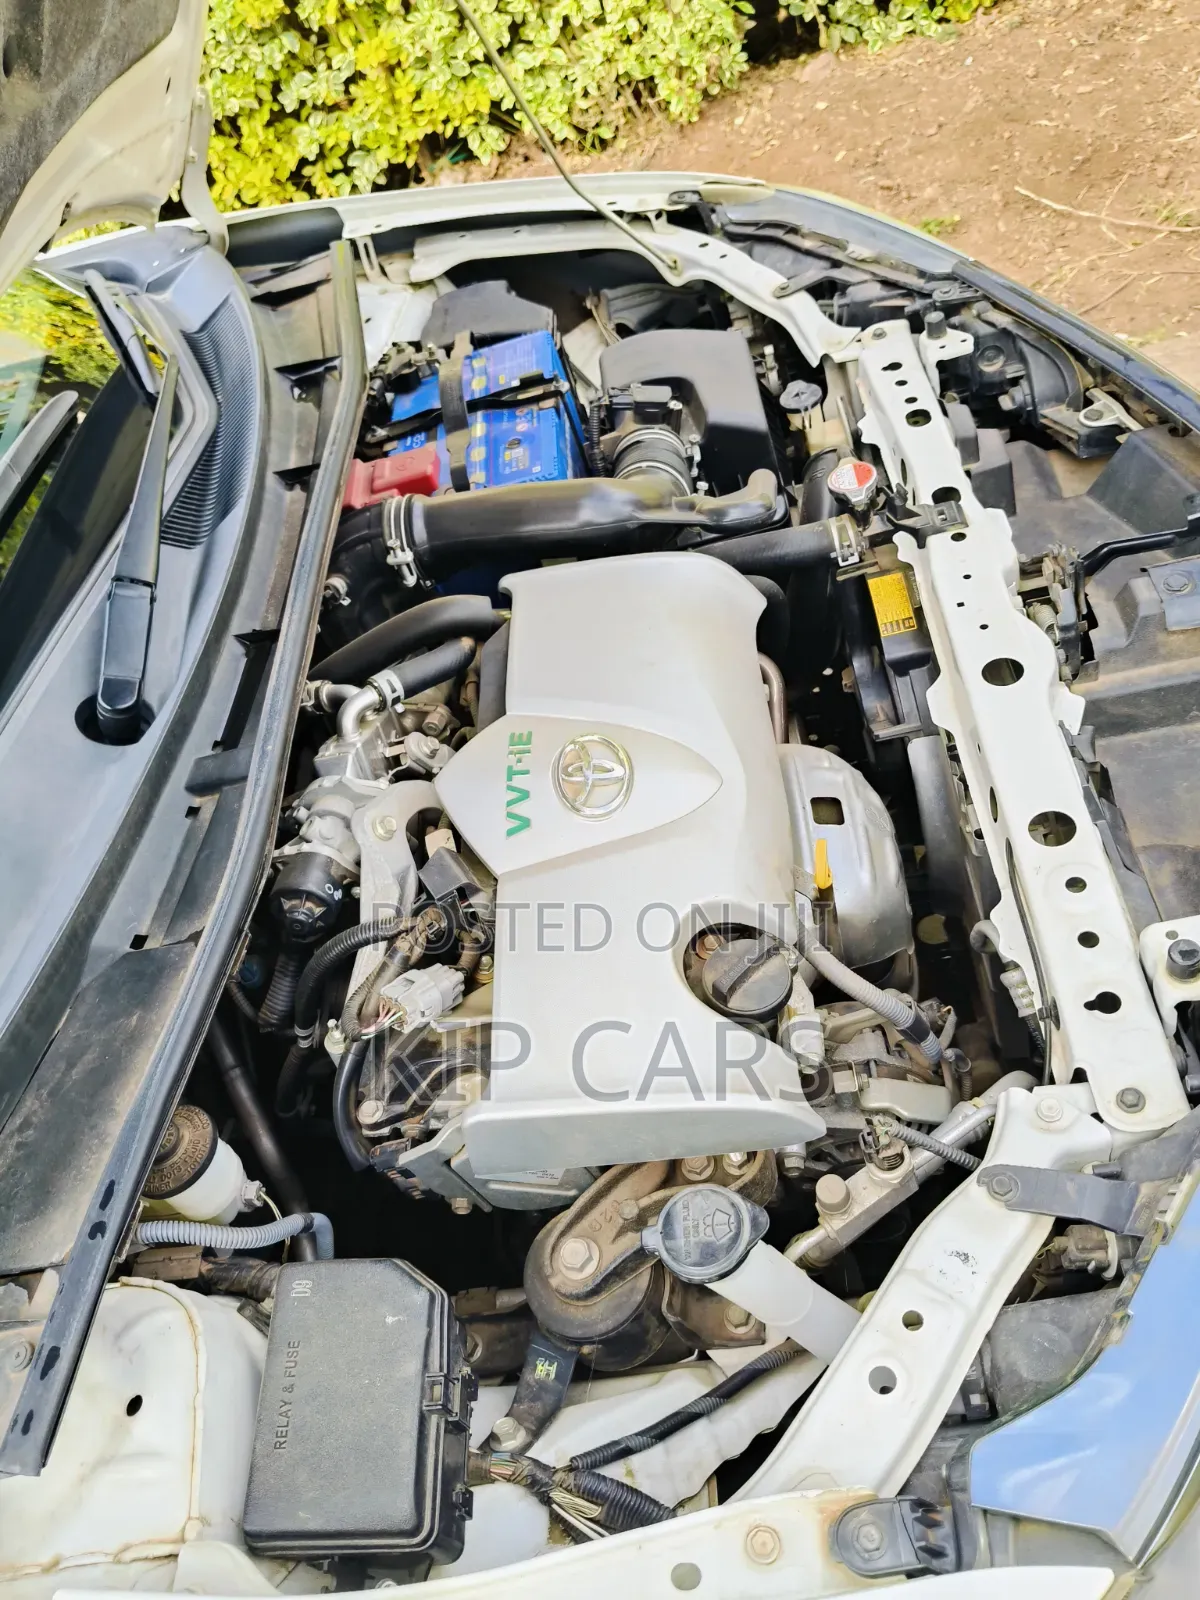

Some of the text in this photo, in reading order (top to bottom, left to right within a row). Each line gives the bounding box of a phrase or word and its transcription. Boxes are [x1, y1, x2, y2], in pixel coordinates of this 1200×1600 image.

[274, 1340, 301, 1450] RELAY & FUSE
